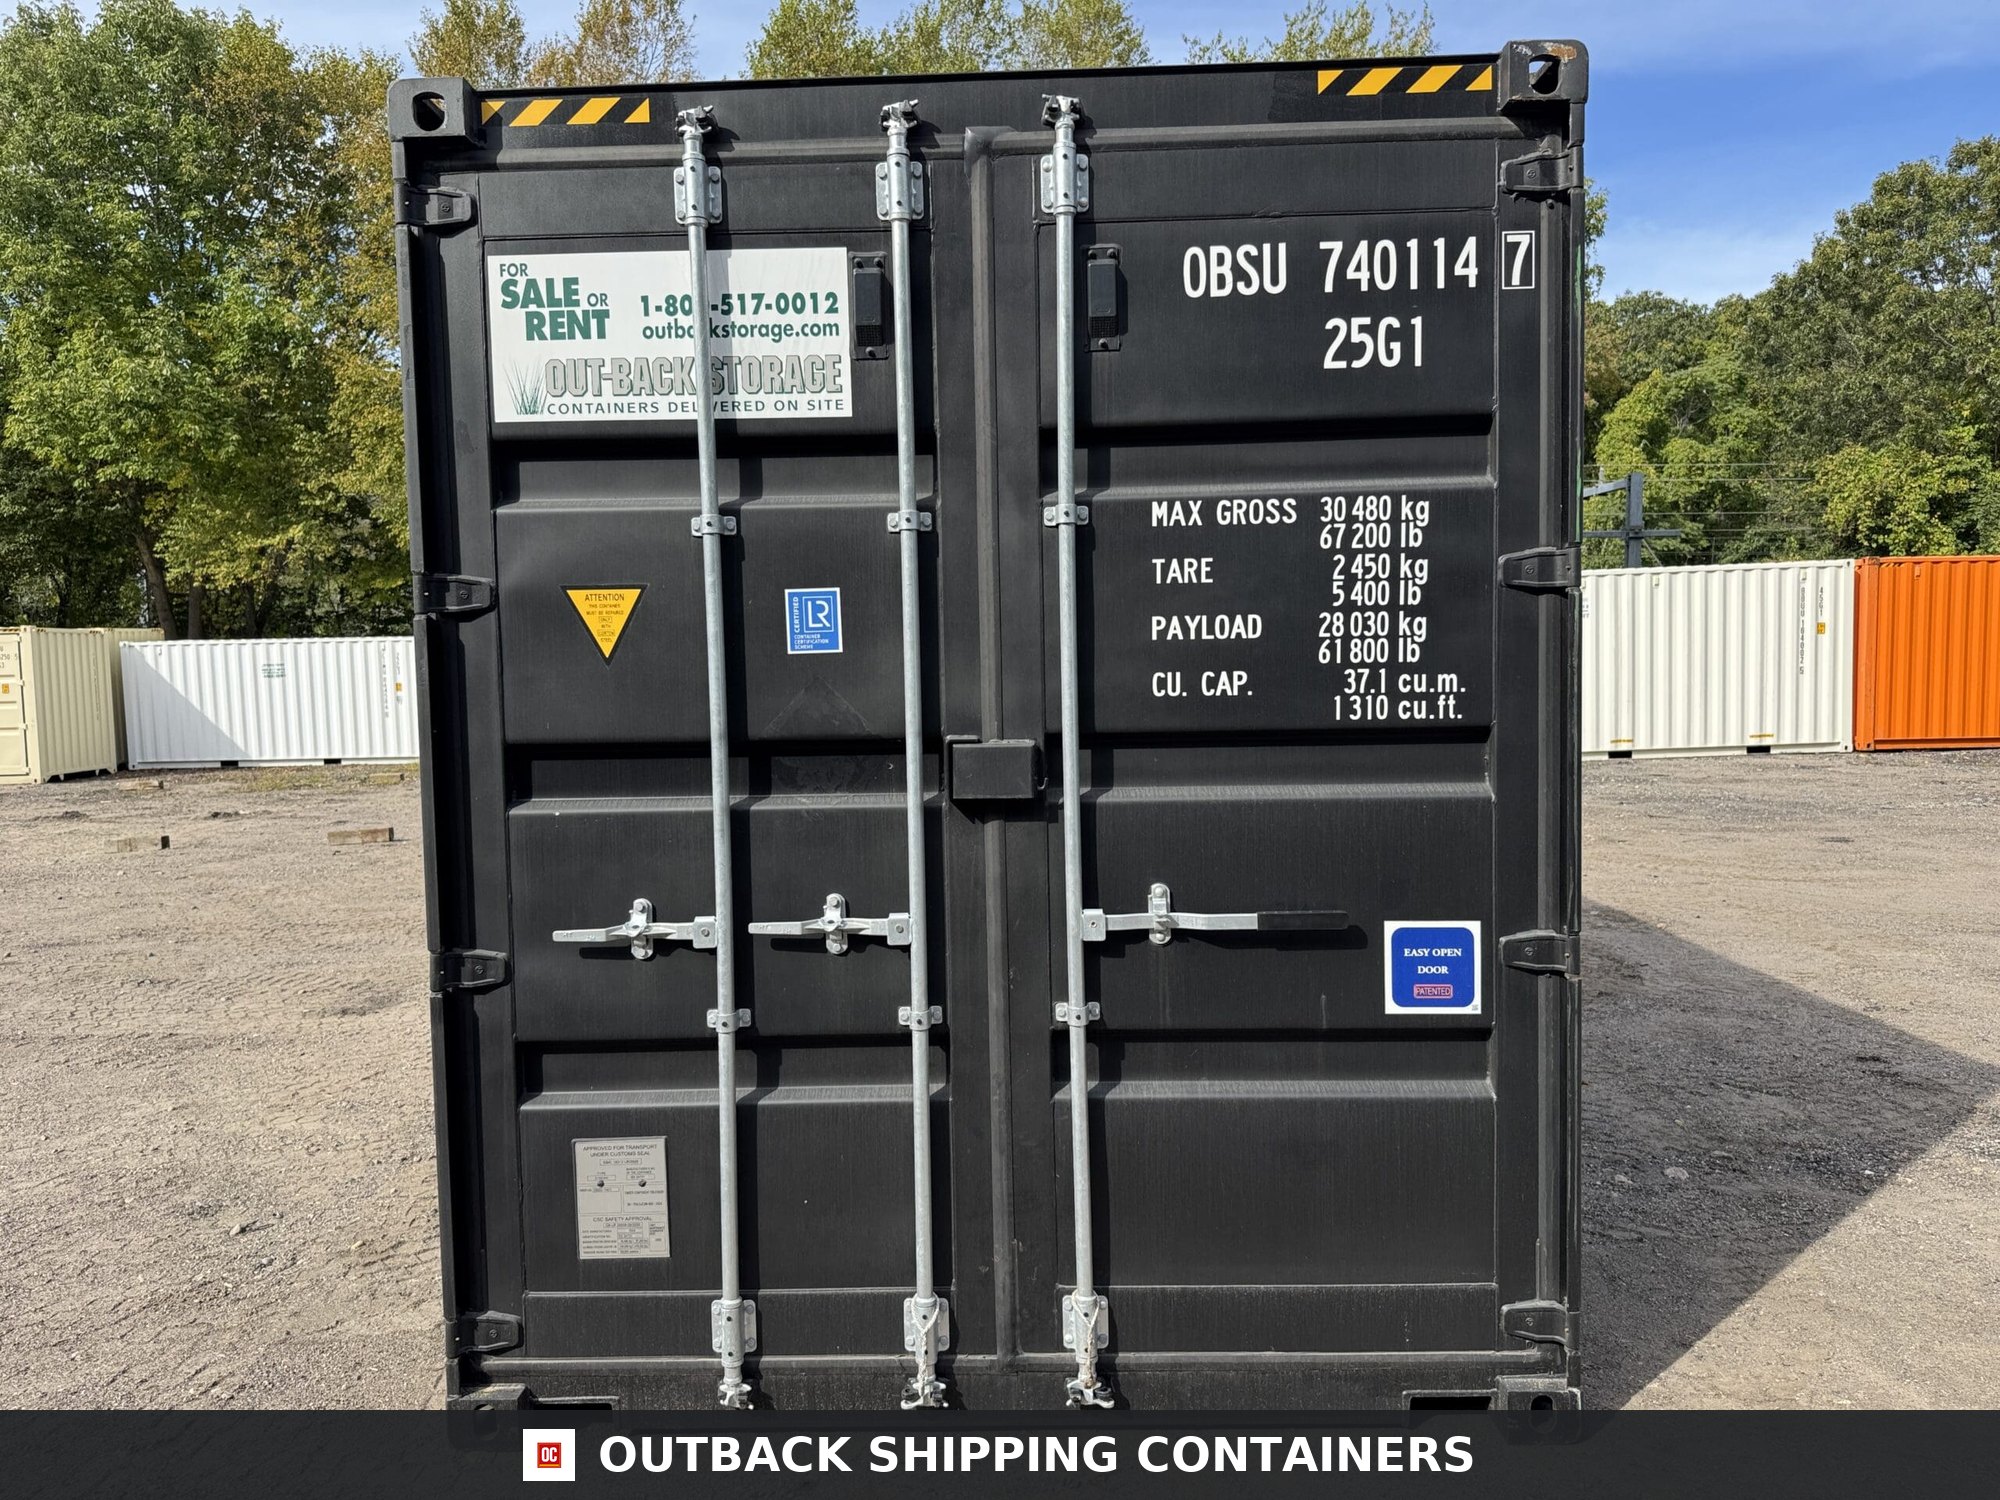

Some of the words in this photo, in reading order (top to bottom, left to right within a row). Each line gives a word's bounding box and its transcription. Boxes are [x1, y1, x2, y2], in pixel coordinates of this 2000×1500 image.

[500, 263, 528, 277] FOR
[1183, 242, 1287, 298] OBSU
[1319, 236, 1478, 292] 740114
[1506, 234, 1531, 286] 7
[500, 277, 581, 309] SALE
[587, 293, 608, 307] OR
[640, 292, 839, 318] 1-80-517-0012
[525, 308, 610, 341] RENT
[642, 318, 840, 343] outbakstorage.com
[1323, 316, 1422, 369] 25G1
[545, 356, 697, 397] OUT-BACK
[547, 402, 660, 415] CONTAINERS
[774, 399, 798, 412] ON
[806, 398, 845, 411] SITE
[1152, 500, 1202, 527] MAX
[1216, 498, 1297, 525] GROSS
[1320, 496, 1346, 522] 30
[1352, 495, 1392, 521] 480
[1400, 494, 1430, 527] kg
[1319, 523, 1346, 549] 67
[1351, 522, 1392, 549] 200
[1400, 522, 1423, 548] lb
[1152, 557, 1214, 584] TARE
[1333, 555, 1345, 580] 2
[1350, 553, 1391, 580] 450
[1400, 553, 1429, 584] kg
[585, 593, 625, 602] ATTENTION
[1332, 581, 1345, 606] 5
[1350, 580, 1390, 606] 400
[1399, 580, 1421, 605] lb
[807, 600, 831, 628] LR
[1151, 614, 1262, 641] PAYLOAD
[1318, 612, 1345, 638] 28
[1350, 611, 1389, 637] 030
[1398, 610, 1427, 643] kg
[1318, 639, 1342, 664] 61
[1350, 638, 1389, 663] 800
[1398, 637, 1420, 663] lb
[1152, 671, 1187, 697] CU.
[1201, 671, 1253, 697] CAP.
[1343, 669, 1386, 694] 37.1
[1398, 672, 1466, 693] cu.m.
[1333, 696, 1341, 720] 1
[1349, 695, 1388, 720] 310
[1398, 695, 1463, 720] cu.ft.
[1403, 948, 1430, 957] EASY
[1432, 948, 1462, 957] OPEN
[1417, 966, 1449, 974] DOOR
[1416, 987, 1451, 996] PATENTED
